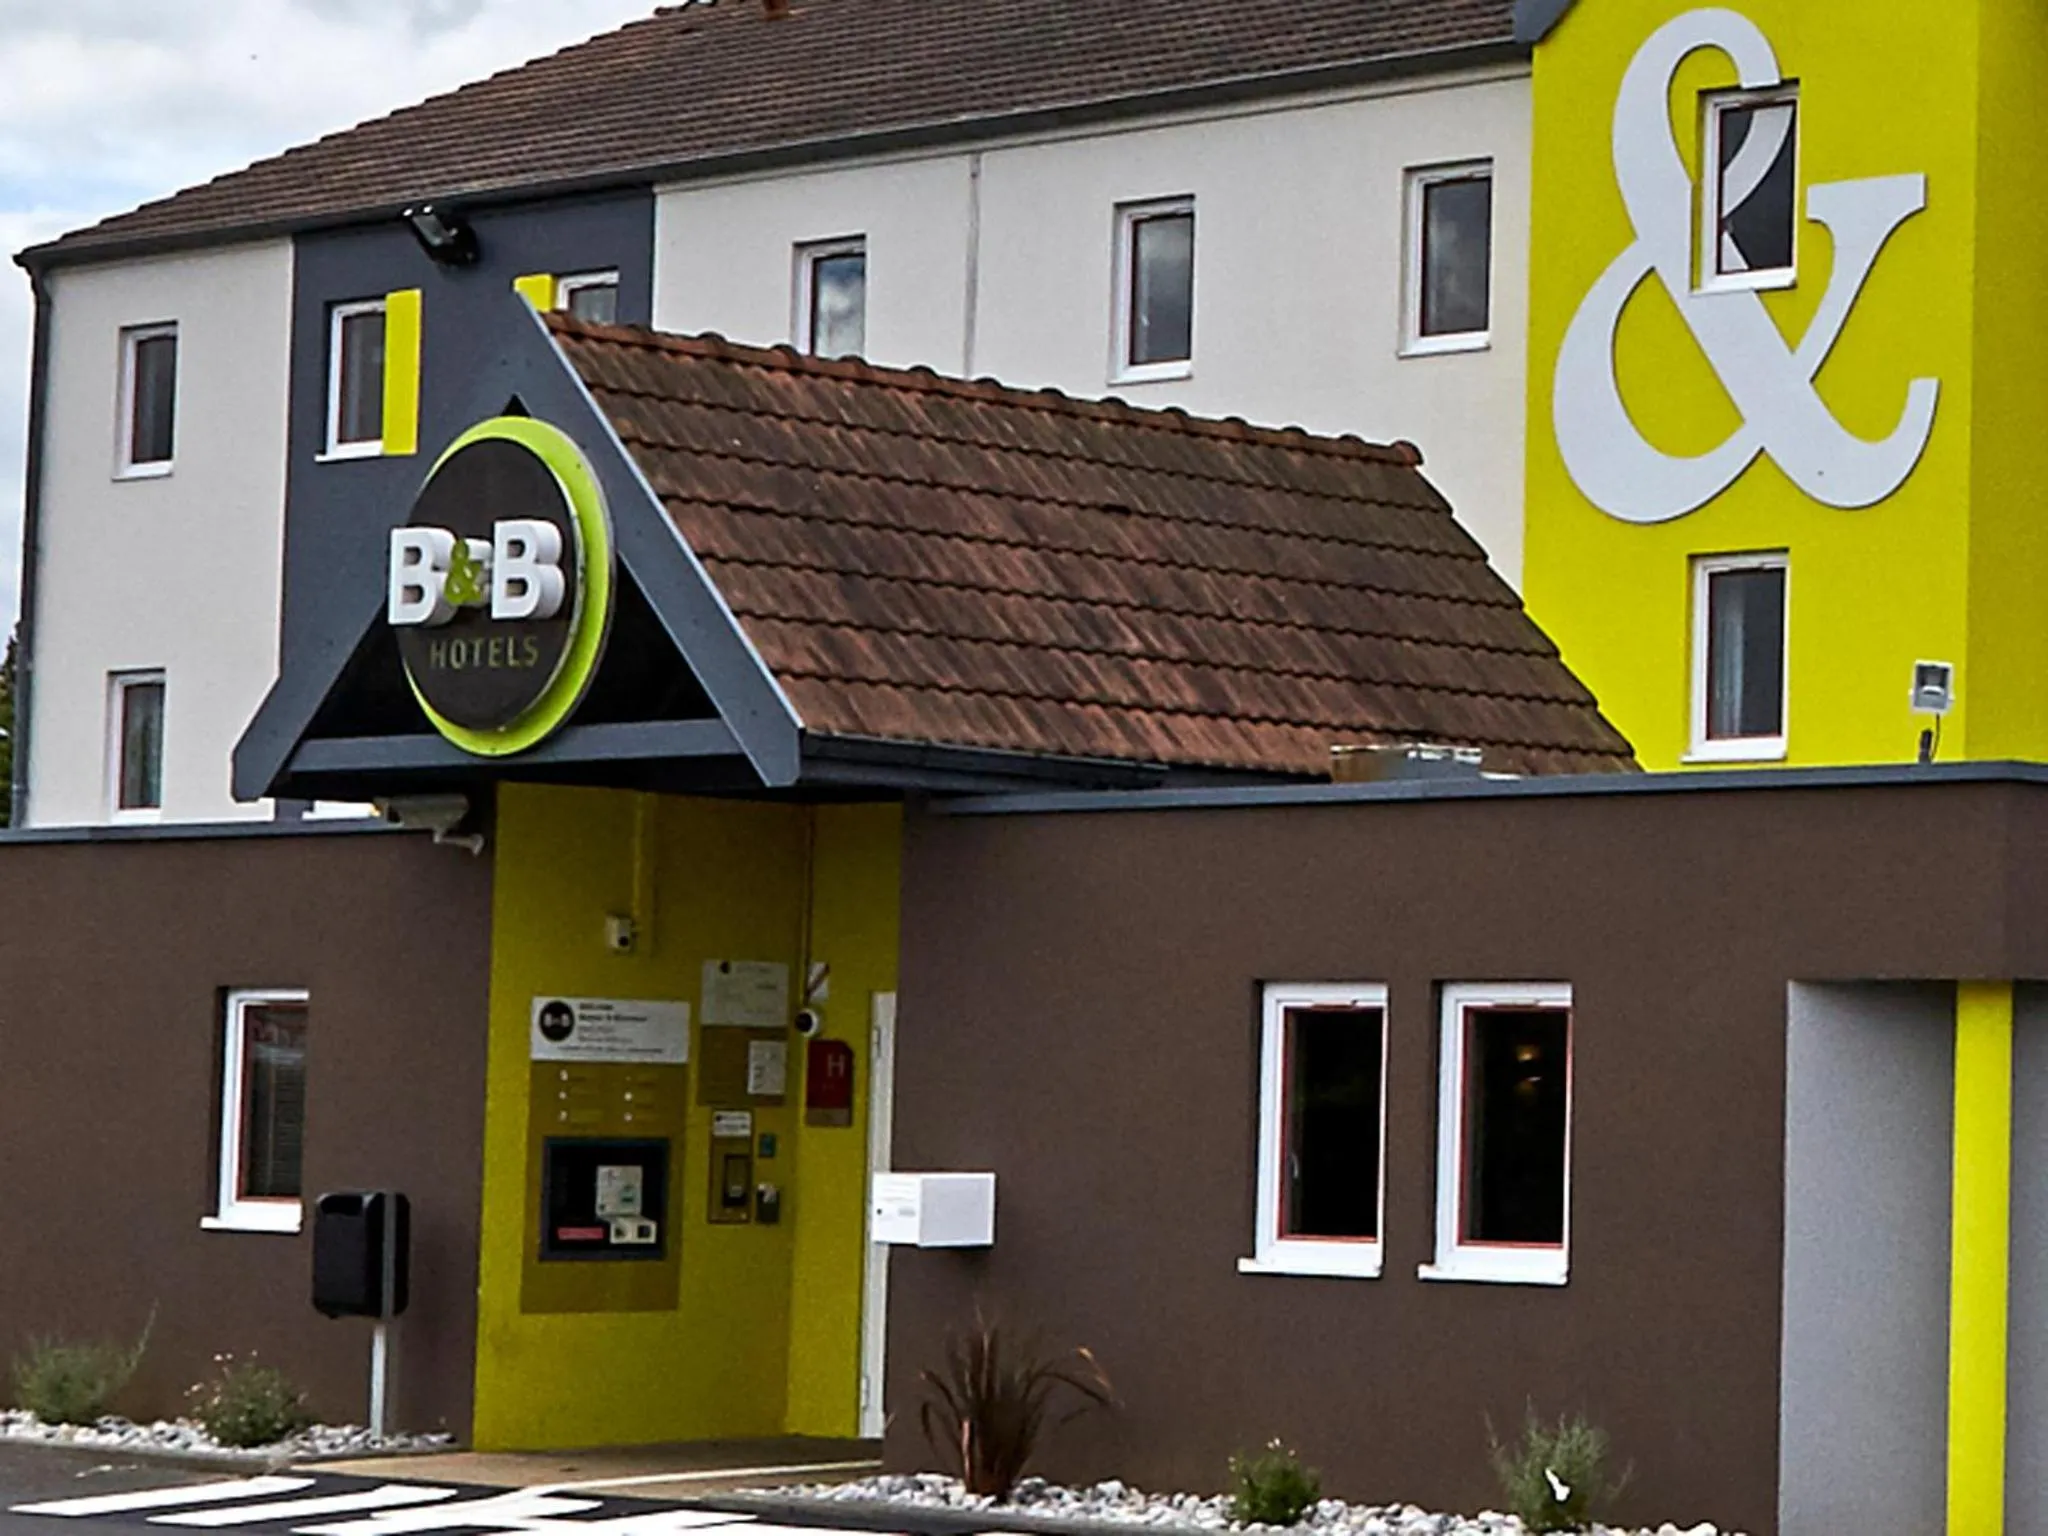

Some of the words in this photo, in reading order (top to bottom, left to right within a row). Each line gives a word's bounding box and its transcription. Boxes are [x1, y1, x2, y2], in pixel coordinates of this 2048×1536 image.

[1553, 7, 1940, 524] &
[388, 519, 566, 626] B&B
[429, 636, 540, 670] HOTELS
[826, 1052, 846, 1079] H
